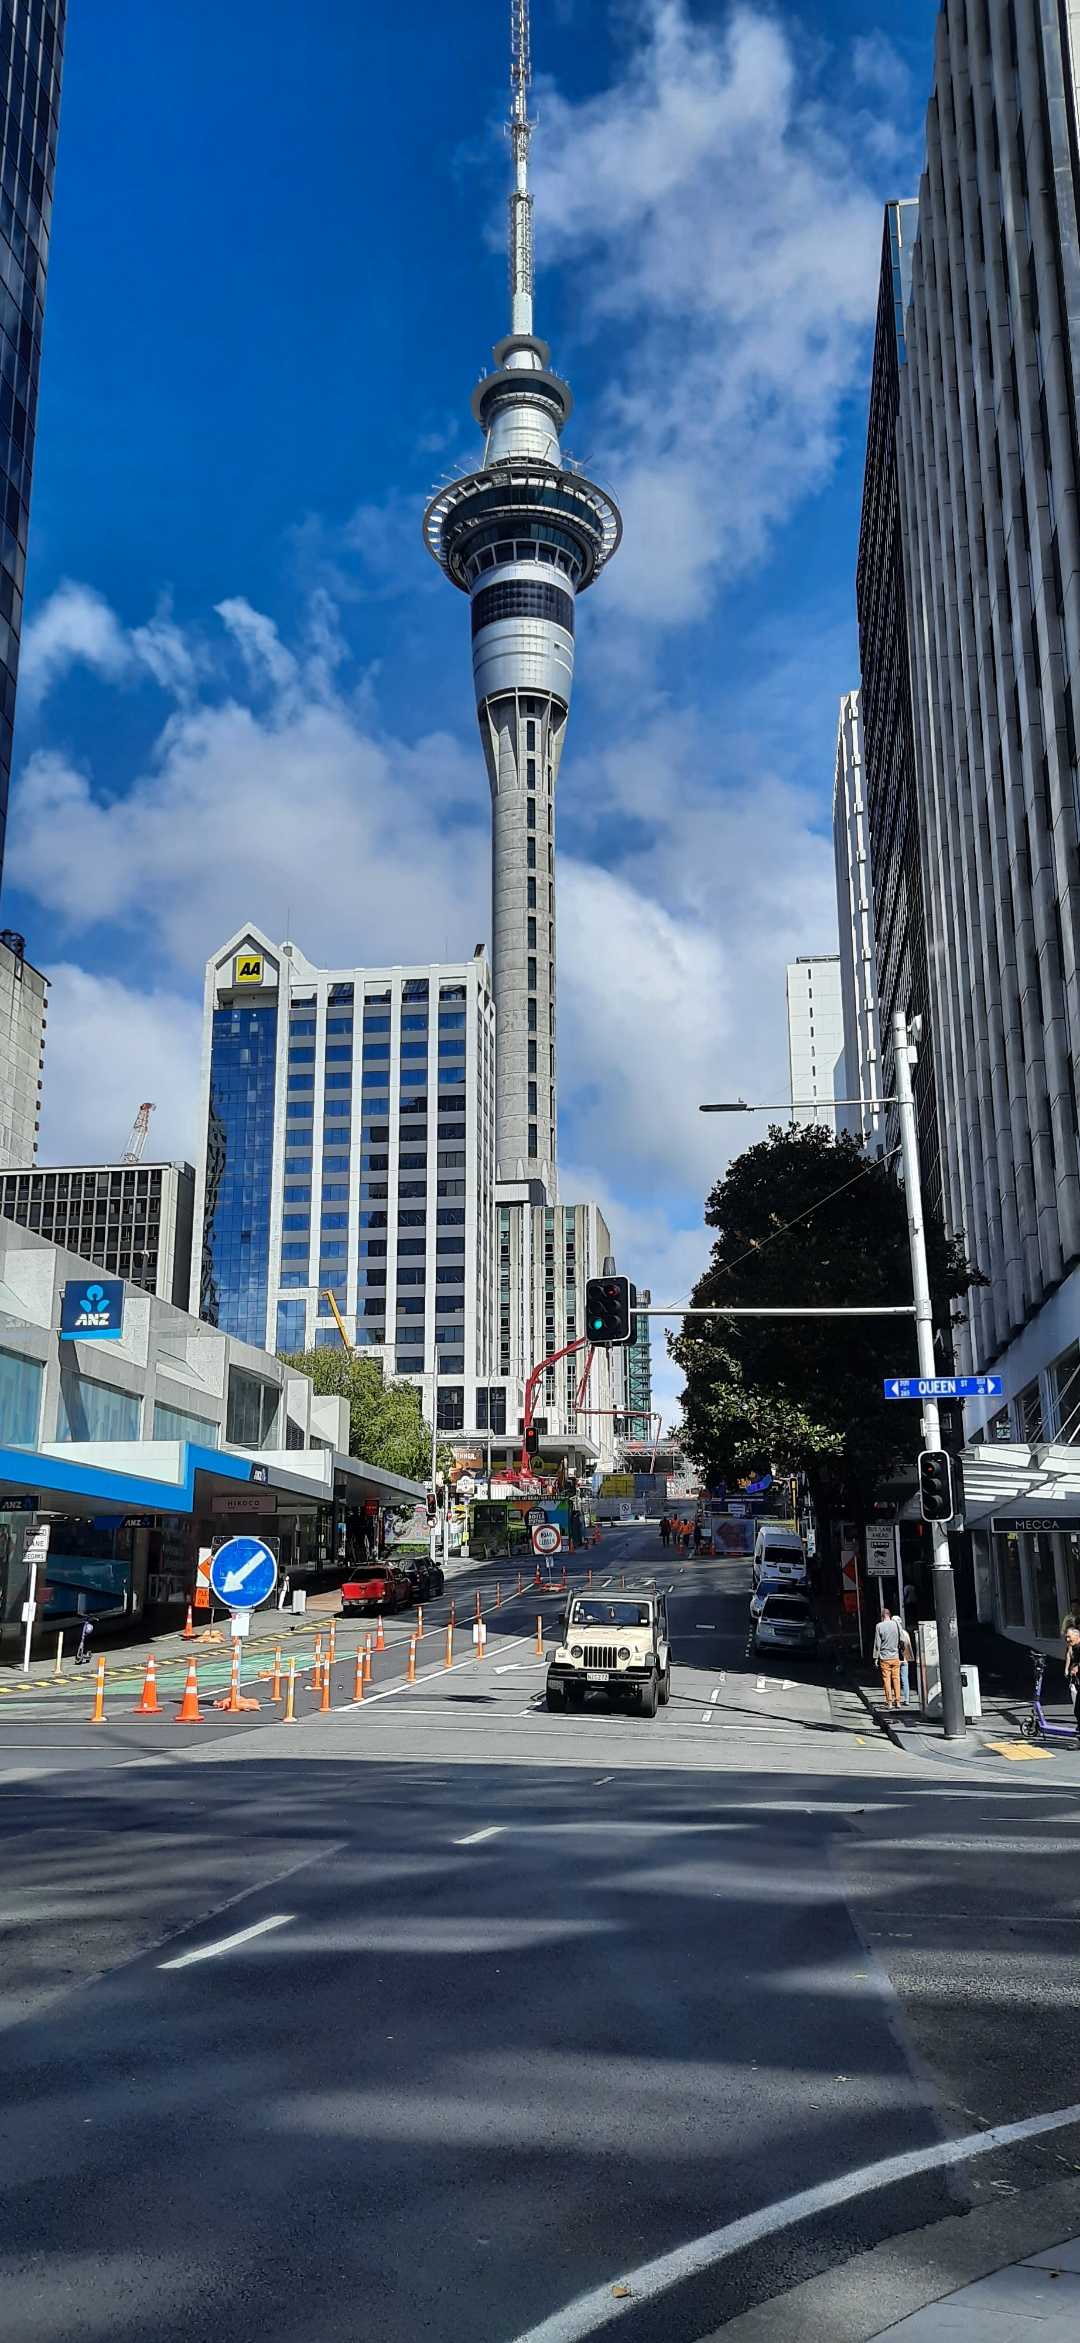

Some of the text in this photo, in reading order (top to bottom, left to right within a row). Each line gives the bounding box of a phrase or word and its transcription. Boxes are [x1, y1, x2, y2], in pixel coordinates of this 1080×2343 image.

[240, 962, 261, 976] AA
[75, 1313, 110, 1326] ANZ
[918, 1380, 956, 1394] QUEEN
[960, 1380, 968, 1388] ST
[1015, 1519, 1060, 1530] MECCA
